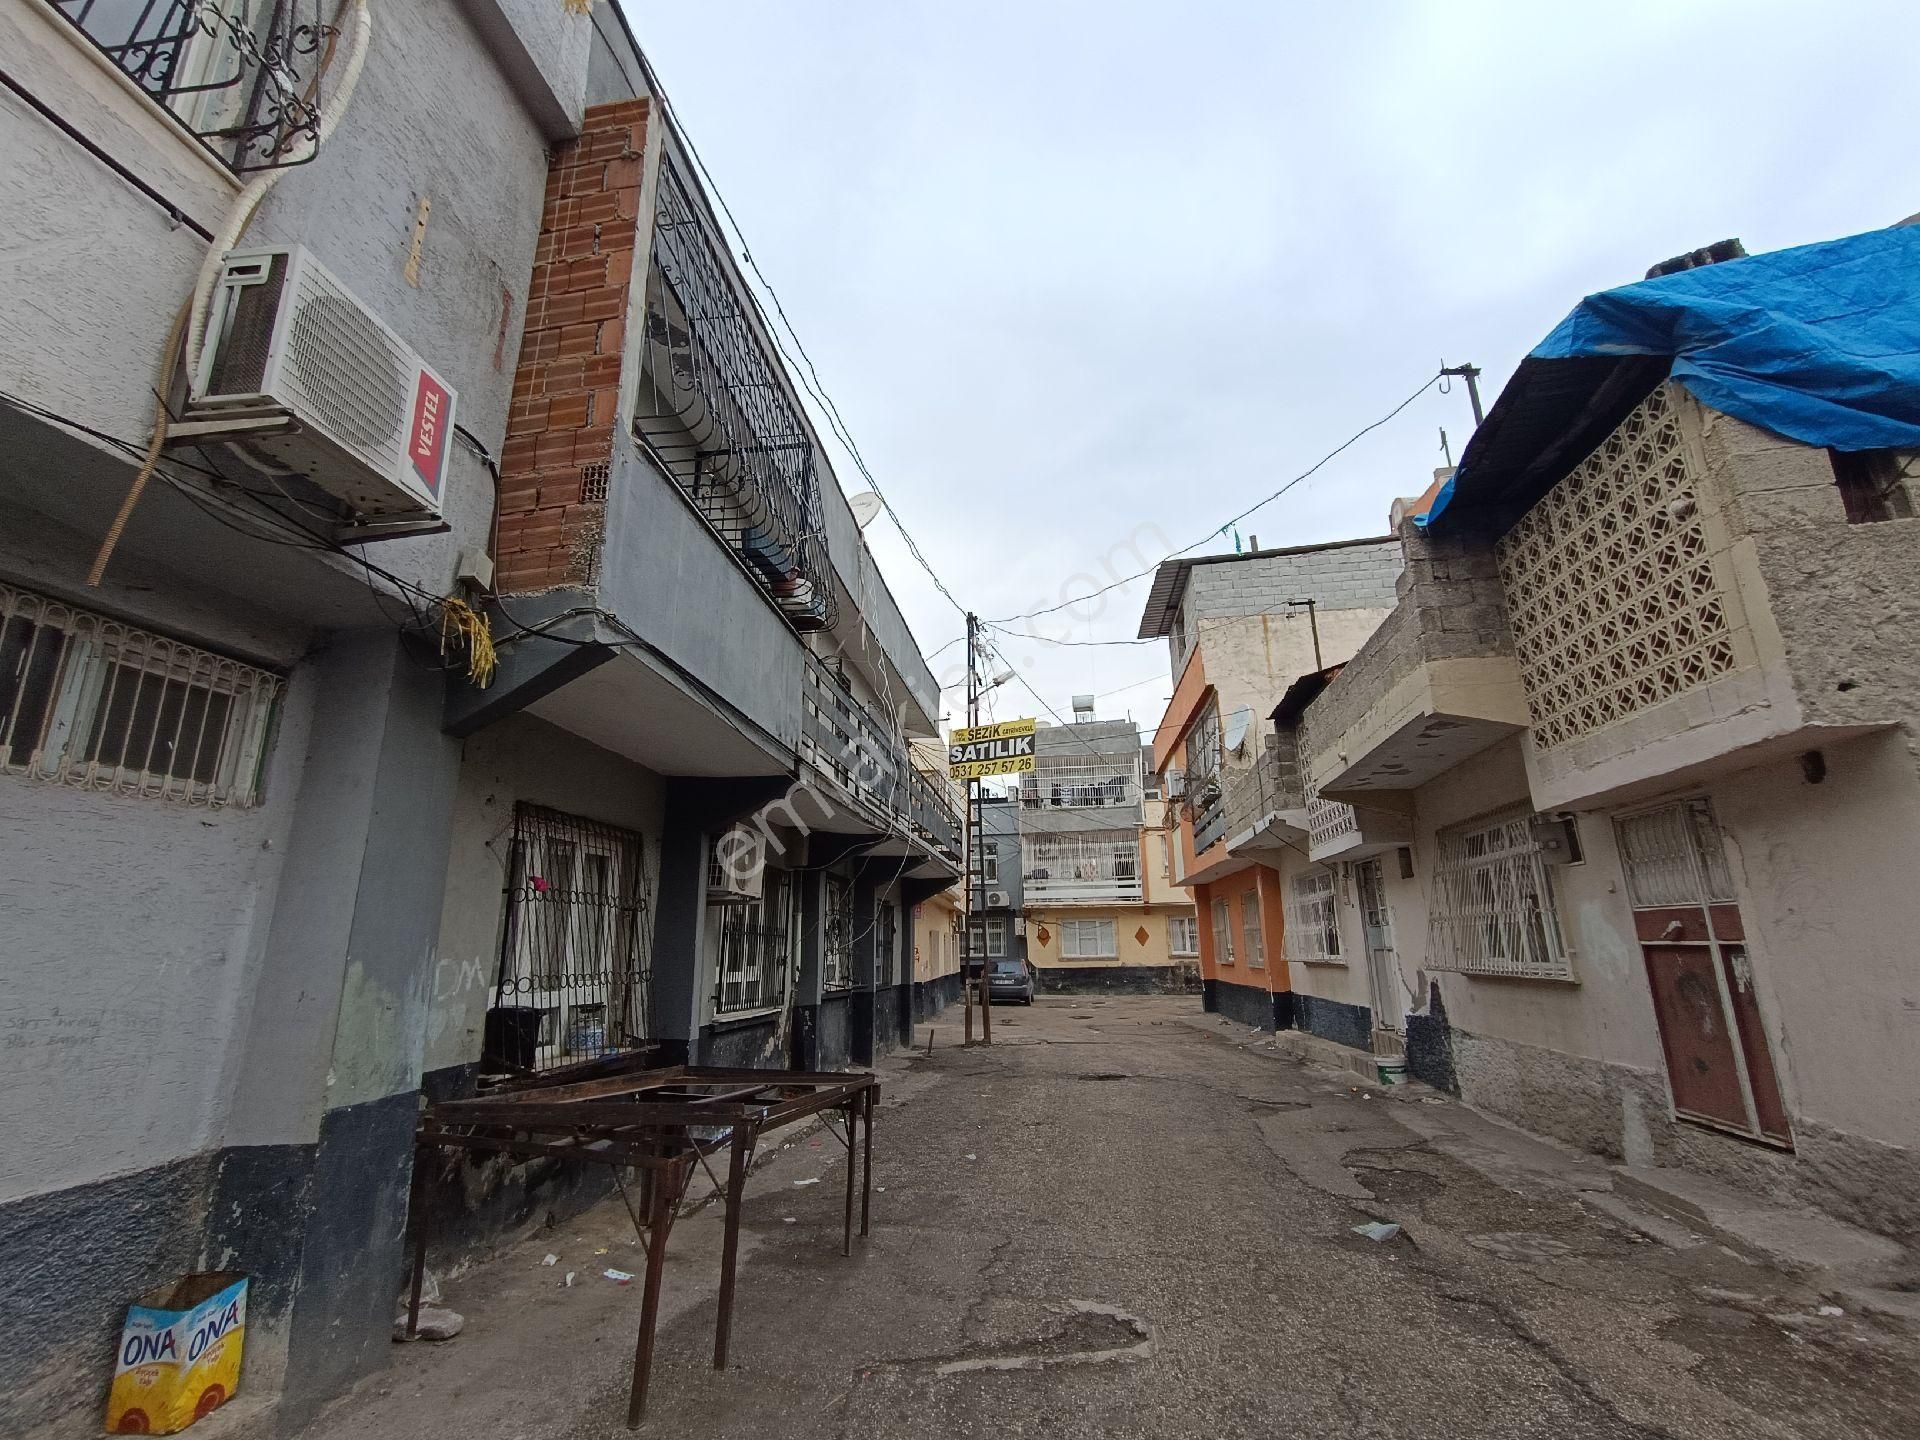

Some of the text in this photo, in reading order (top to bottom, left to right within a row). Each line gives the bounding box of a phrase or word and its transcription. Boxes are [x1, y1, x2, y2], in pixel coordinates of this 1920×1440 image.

[417, 390, 440, 457] VESTEL
[949, 758, 1032, 779] 0531 257 57 26
[950, 736, 1032, 763] SATILIK
[123, 1328, 177, 1366] ONA
[189, 1300, 239, 1361] ONA
